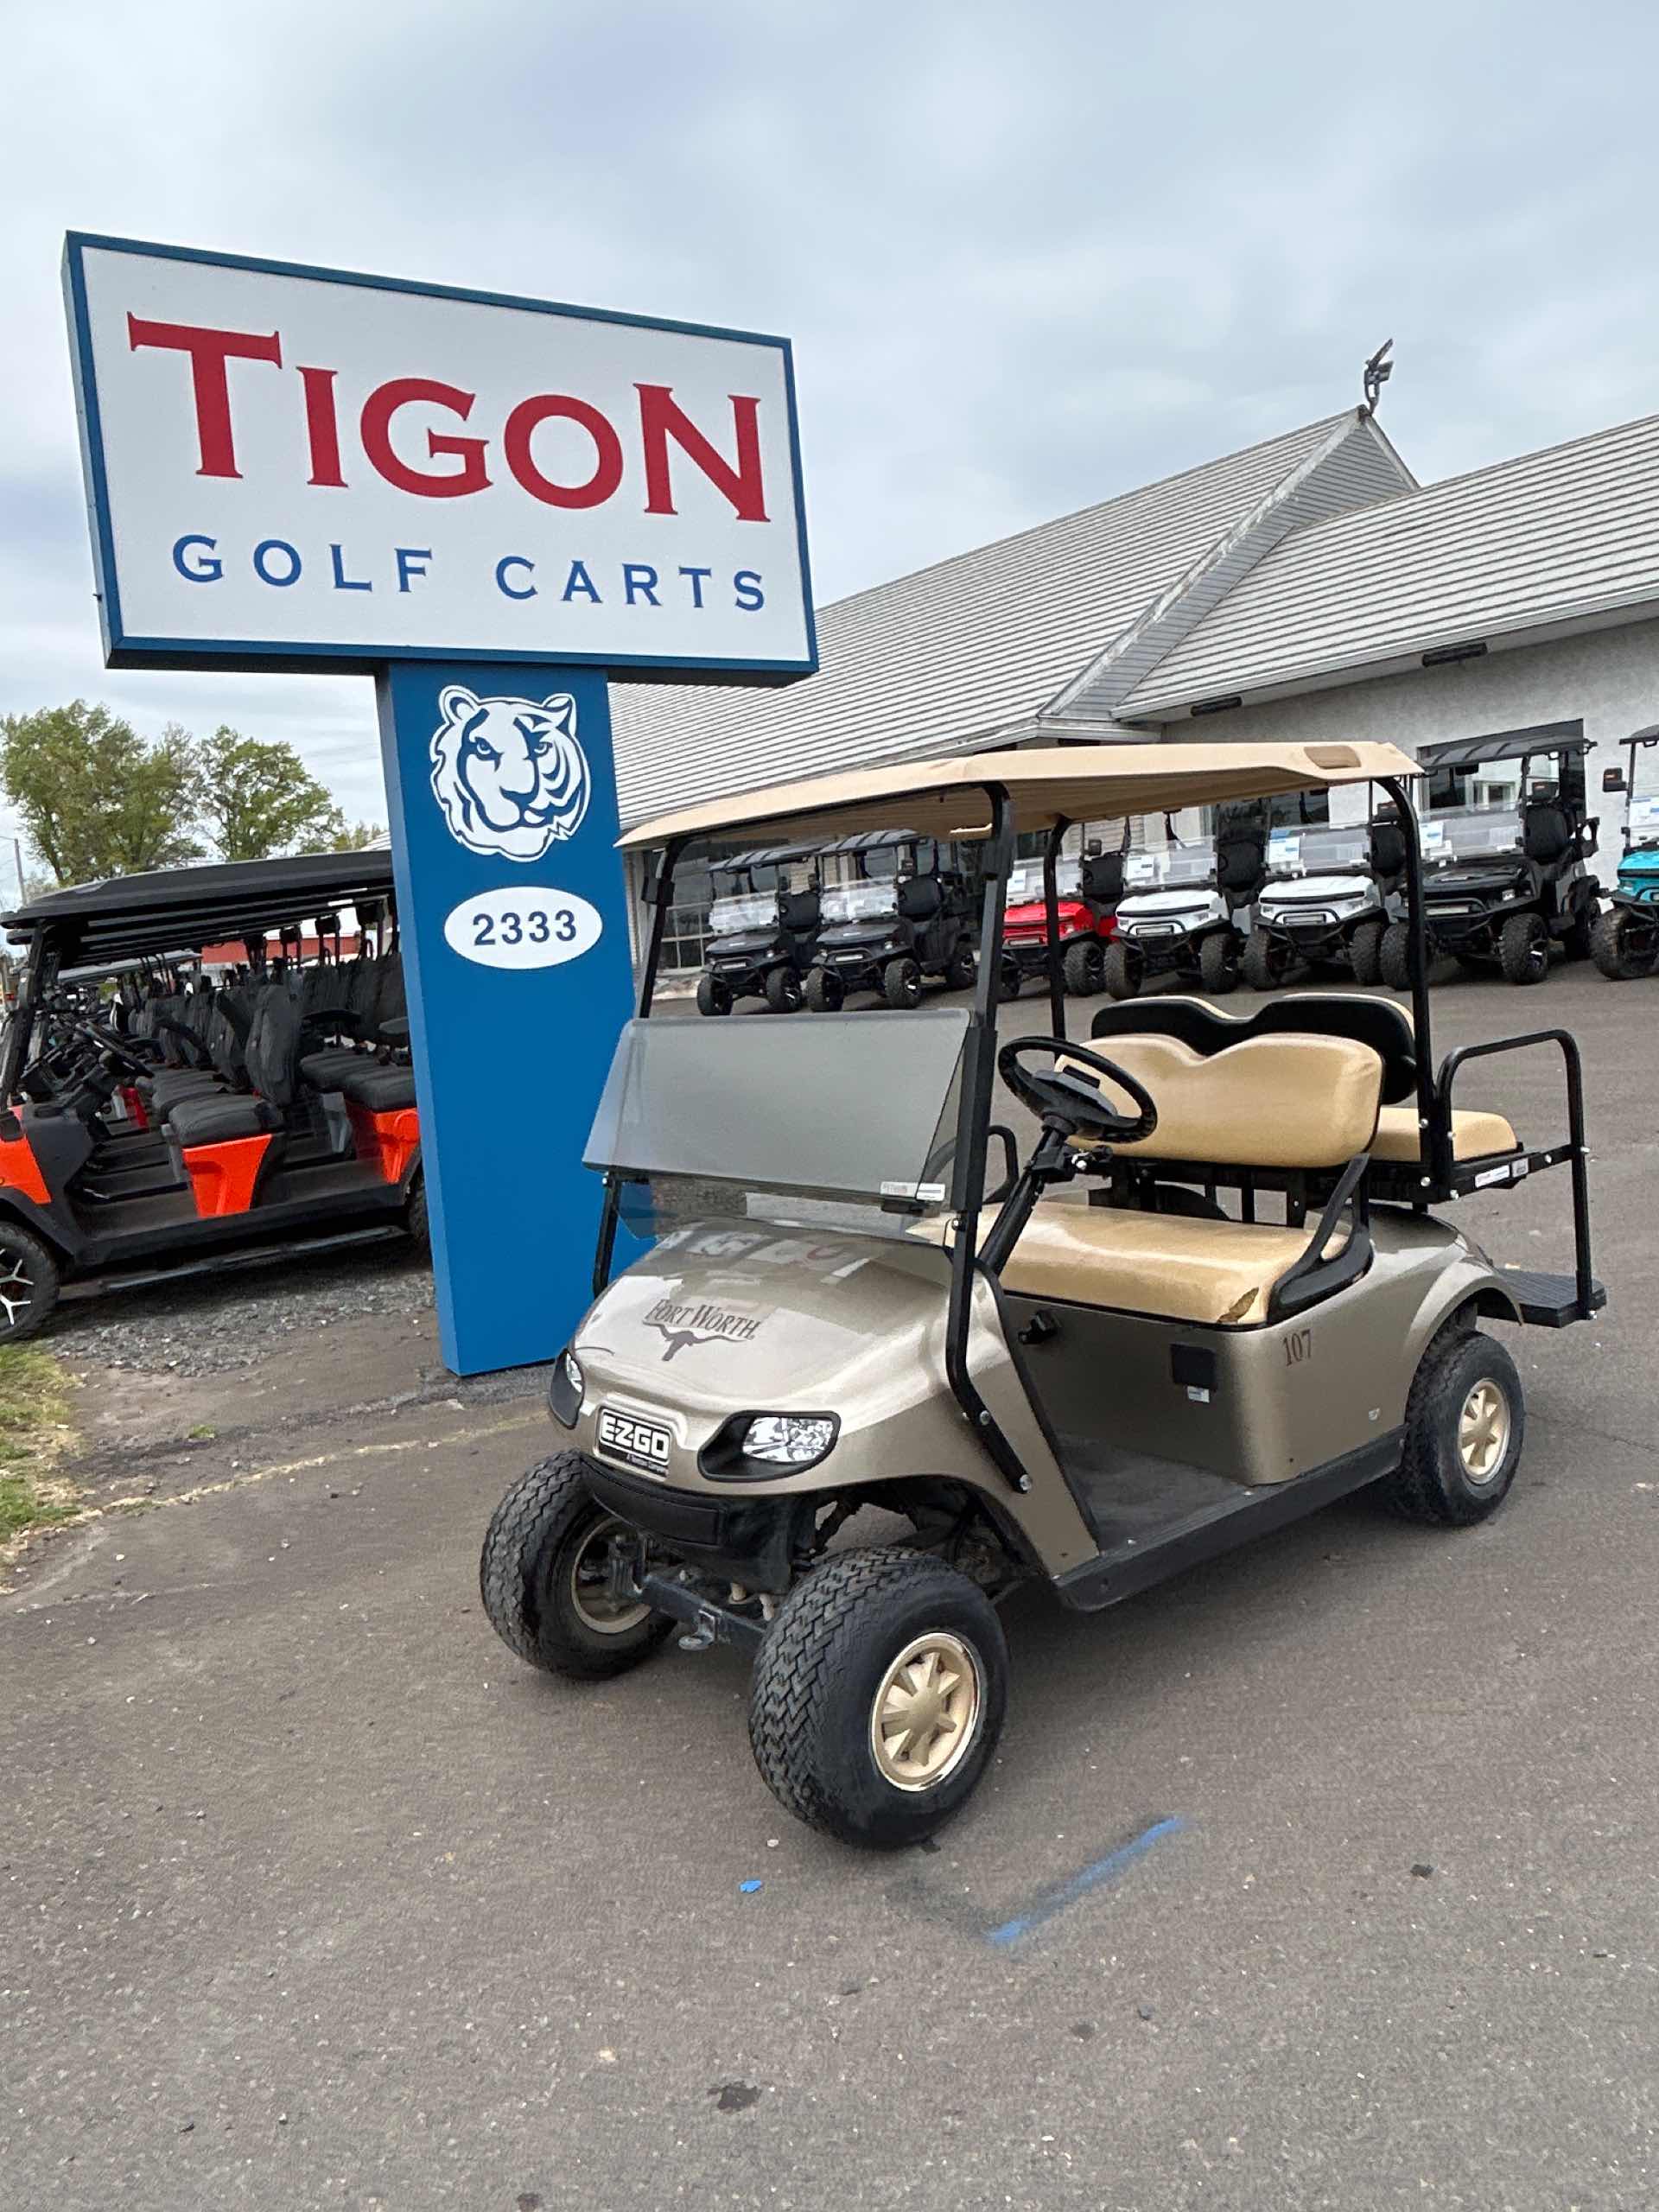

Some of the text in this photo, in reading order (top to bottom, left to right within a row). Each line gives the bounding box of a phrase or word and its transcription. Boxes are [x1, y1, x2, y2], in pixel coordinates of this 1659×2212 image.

[127, 311, 770, 523] TIGON
[173, 534, 766, 612] GOLF CARTS
[472, 909, 577, 946] 2333
[1282, 1328, 1313, 1367] 107
